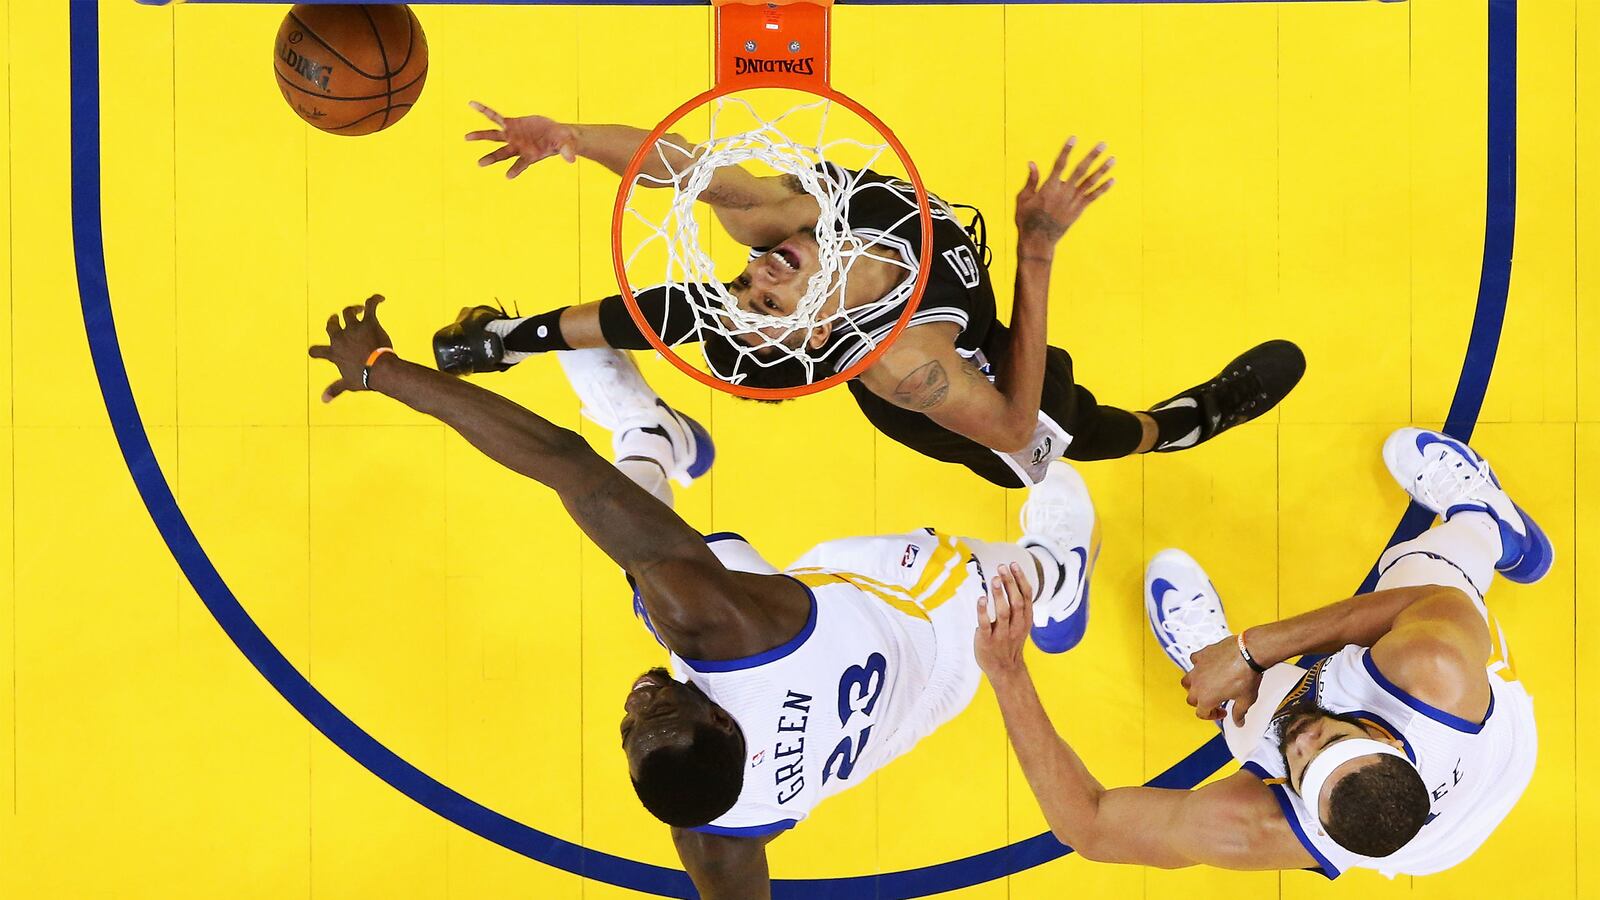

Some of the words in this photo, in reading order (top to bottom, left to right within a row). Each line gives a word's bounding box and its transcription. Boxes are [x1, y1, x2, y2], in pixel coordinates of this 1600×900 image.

[735, 56, 814, 76] SPALDING
[774, 689, 813, 805] GREEN
[822, 652, 887, 787] 23
